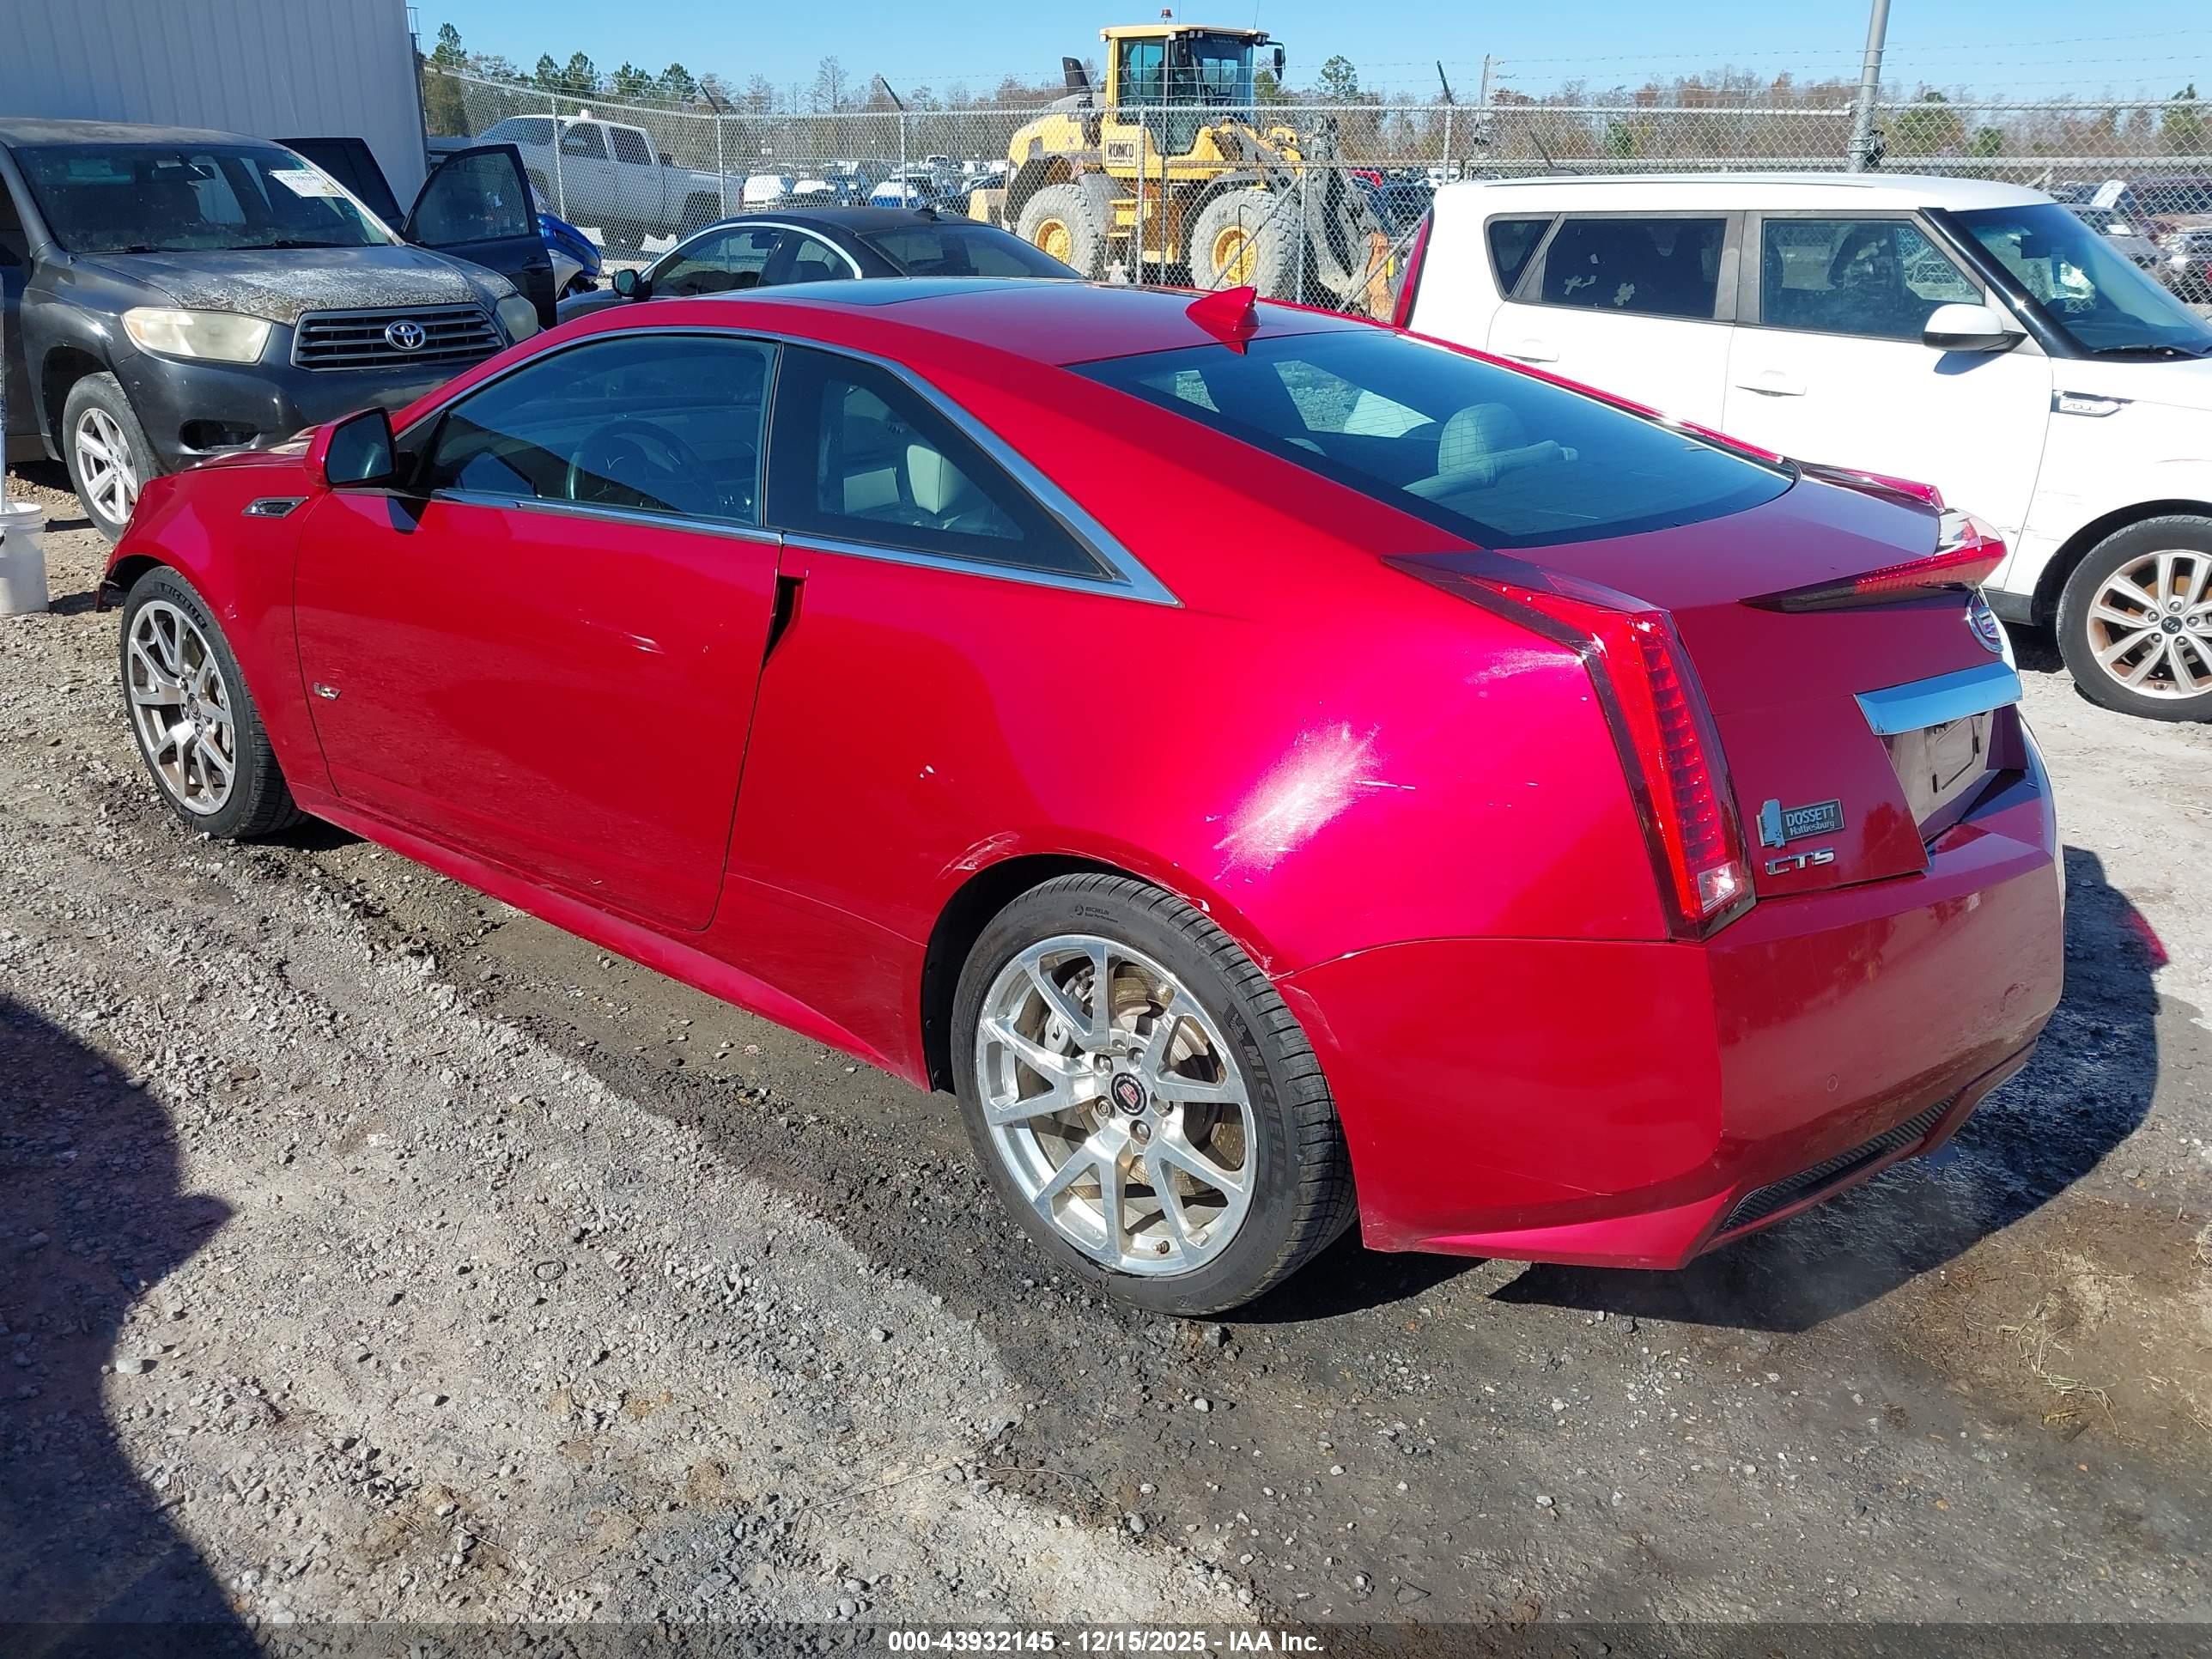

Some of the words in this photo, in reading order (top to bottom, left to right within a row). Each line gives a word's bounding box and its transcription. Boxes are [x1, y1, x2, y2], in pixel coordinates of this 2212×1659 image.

[164, 584, 206, 627] MICHELIN
[1785, 805, 1835, 828] DOSSETT
[1790, 819, 1835, 837] Hattiesburg
[1765, 848, 1835, 875] CTS
